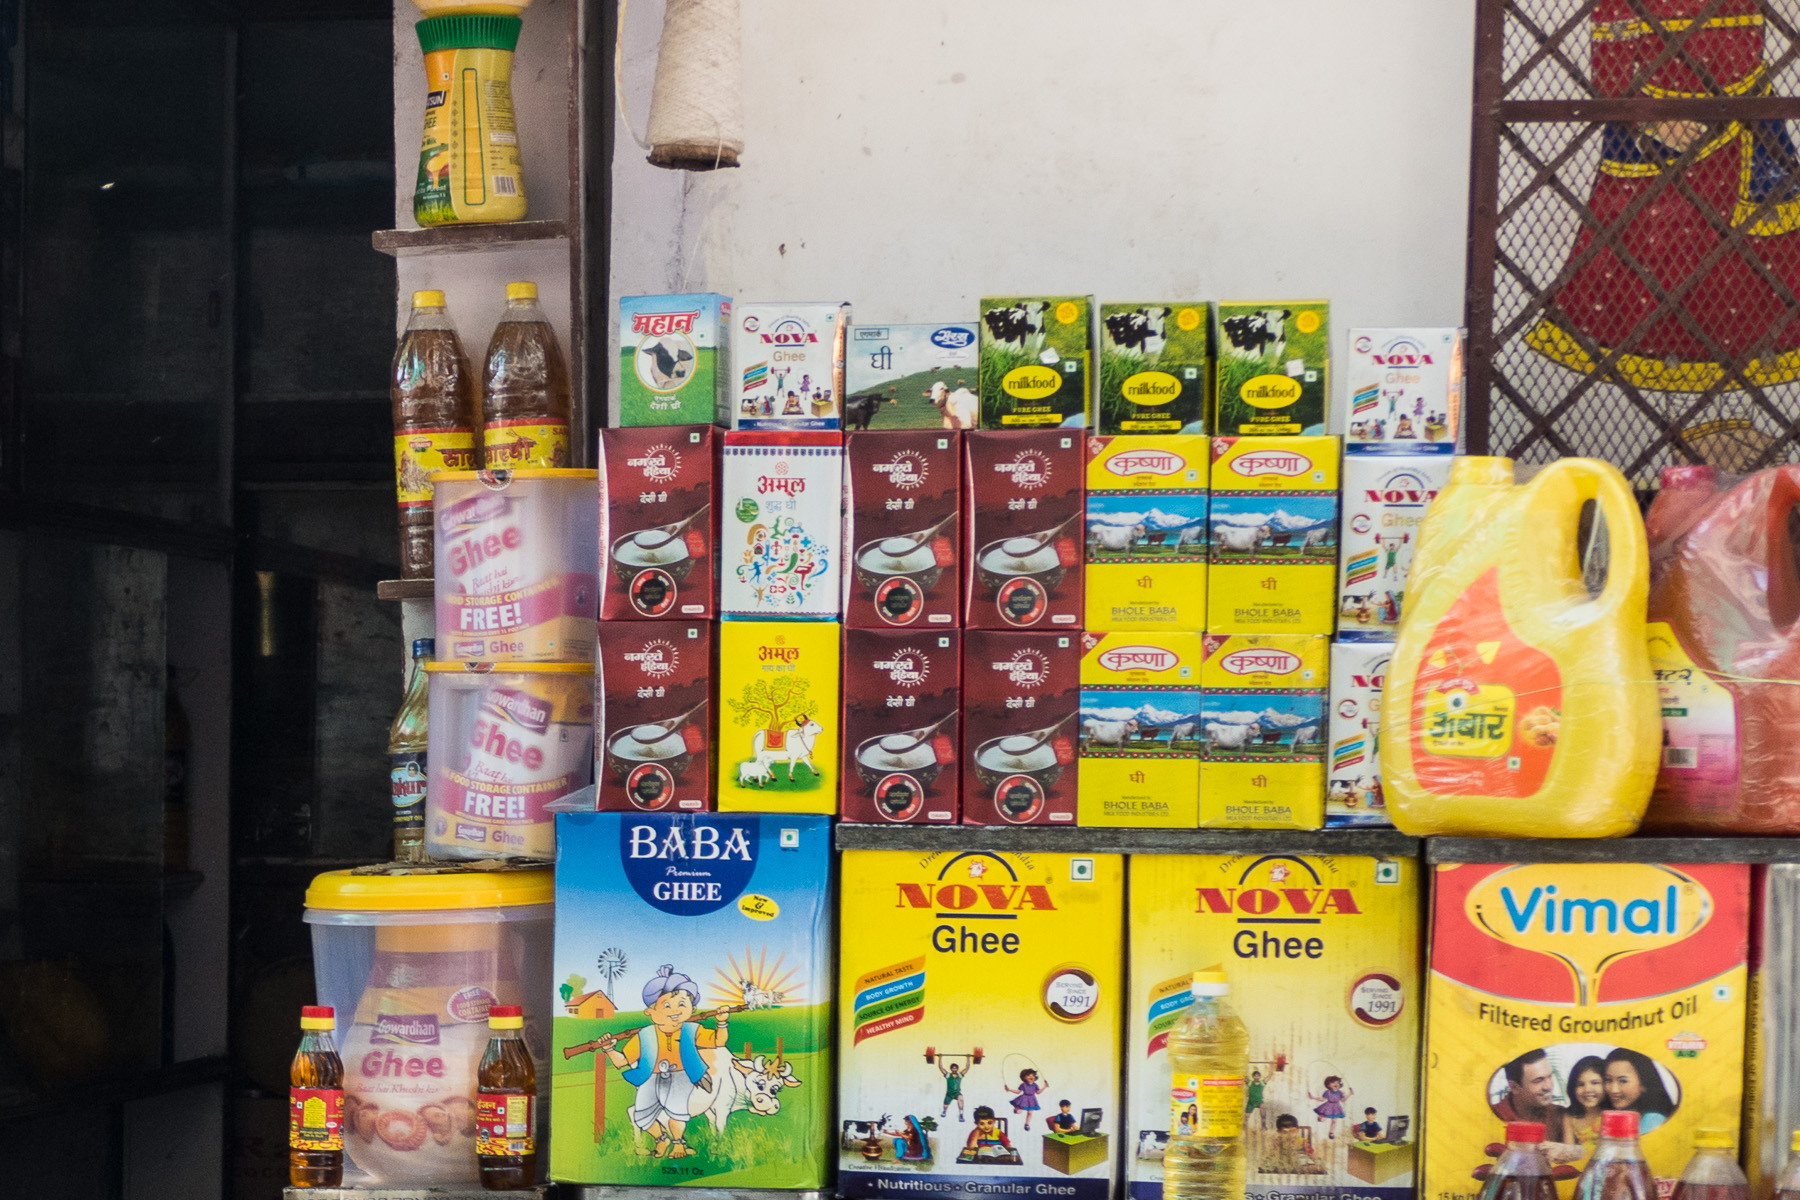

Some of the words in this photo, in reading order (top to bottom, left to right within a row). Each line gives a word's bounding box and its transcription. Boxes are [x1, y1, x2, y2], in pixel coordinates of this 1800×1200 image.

[633, 311, 700, 335] महान
[760, 332, 818, 344] NOVA
[773, 350, 806, 363] Ghee
[870, 346, 893, 371] घी
[1371, 354, 1435, 366] NOVA
[1008, 375, 1056, 391] milkfood
[1385, 372, 1420, 385] Ghee
[1128, 381, 1176, 397] milkfood
[1247, 385, 1296, 402] milkfood
[1114, 454, 1173, 476] कृष्णा
[1239, 454, 1300, 476] कृष्णा
[448, 525, 522, 575] Ghee
[1260, 577, 1277, 593] घी
[460, 603, 523, 631] FREE!
[1234, 608, 1266, 618] BHOLE
[1269, 609, 1301, 619] BABA
[490, 640, 524, 654] Ghee
[1108, 652, 1166, 671] कृष्णा
[1231, 655, 1288, 673] कृष्णा
[470, 719, 544, 769] Ghee
[1129, 770, 1145, 785] घी
[464, 791, 525, 819] FREE!
[1103, 801, 1137, 811] BHOLE
[1140, 800, 1170, 811] BABA
[492, 831, 525, 846] Ghee
[630, 825, 752, 862] BABA
[665, 866, 712, 877] Premium
[653, 882, 722, 901] GHEE
[896, 883, 1058, 911] NOVA
[1195, 888, 1362, 915] NOVA
[1500, 884, 1678, 935] Vimal
[932, 924, 1020, 954] Ghee
[1233, 930, 1324, 958] Ghee
[864, 969, 893, 984] NATURAL
[894, 963, 914, 975] TASTE
[1062, 995, 1091, 1008] 1991
[1368, 1000, 1397, 1014] 1991
[1479, 1002, 1552, 1032] Filtered
[1560, 1007, 1664, 1033] Groundnut
[1671, 995, 1697, 1020] Oil
[866, 1019, 894, 1035] HEALTHY
[895, 1015, 914, 1027] MIND
[362, 1051, 444, 1077] Ghee
[878, 1178, 952, 1193] Nutritious
[965, 1180, 1031, 1195] Granular
[1035, 1184, 1076, 1195] Ghee
